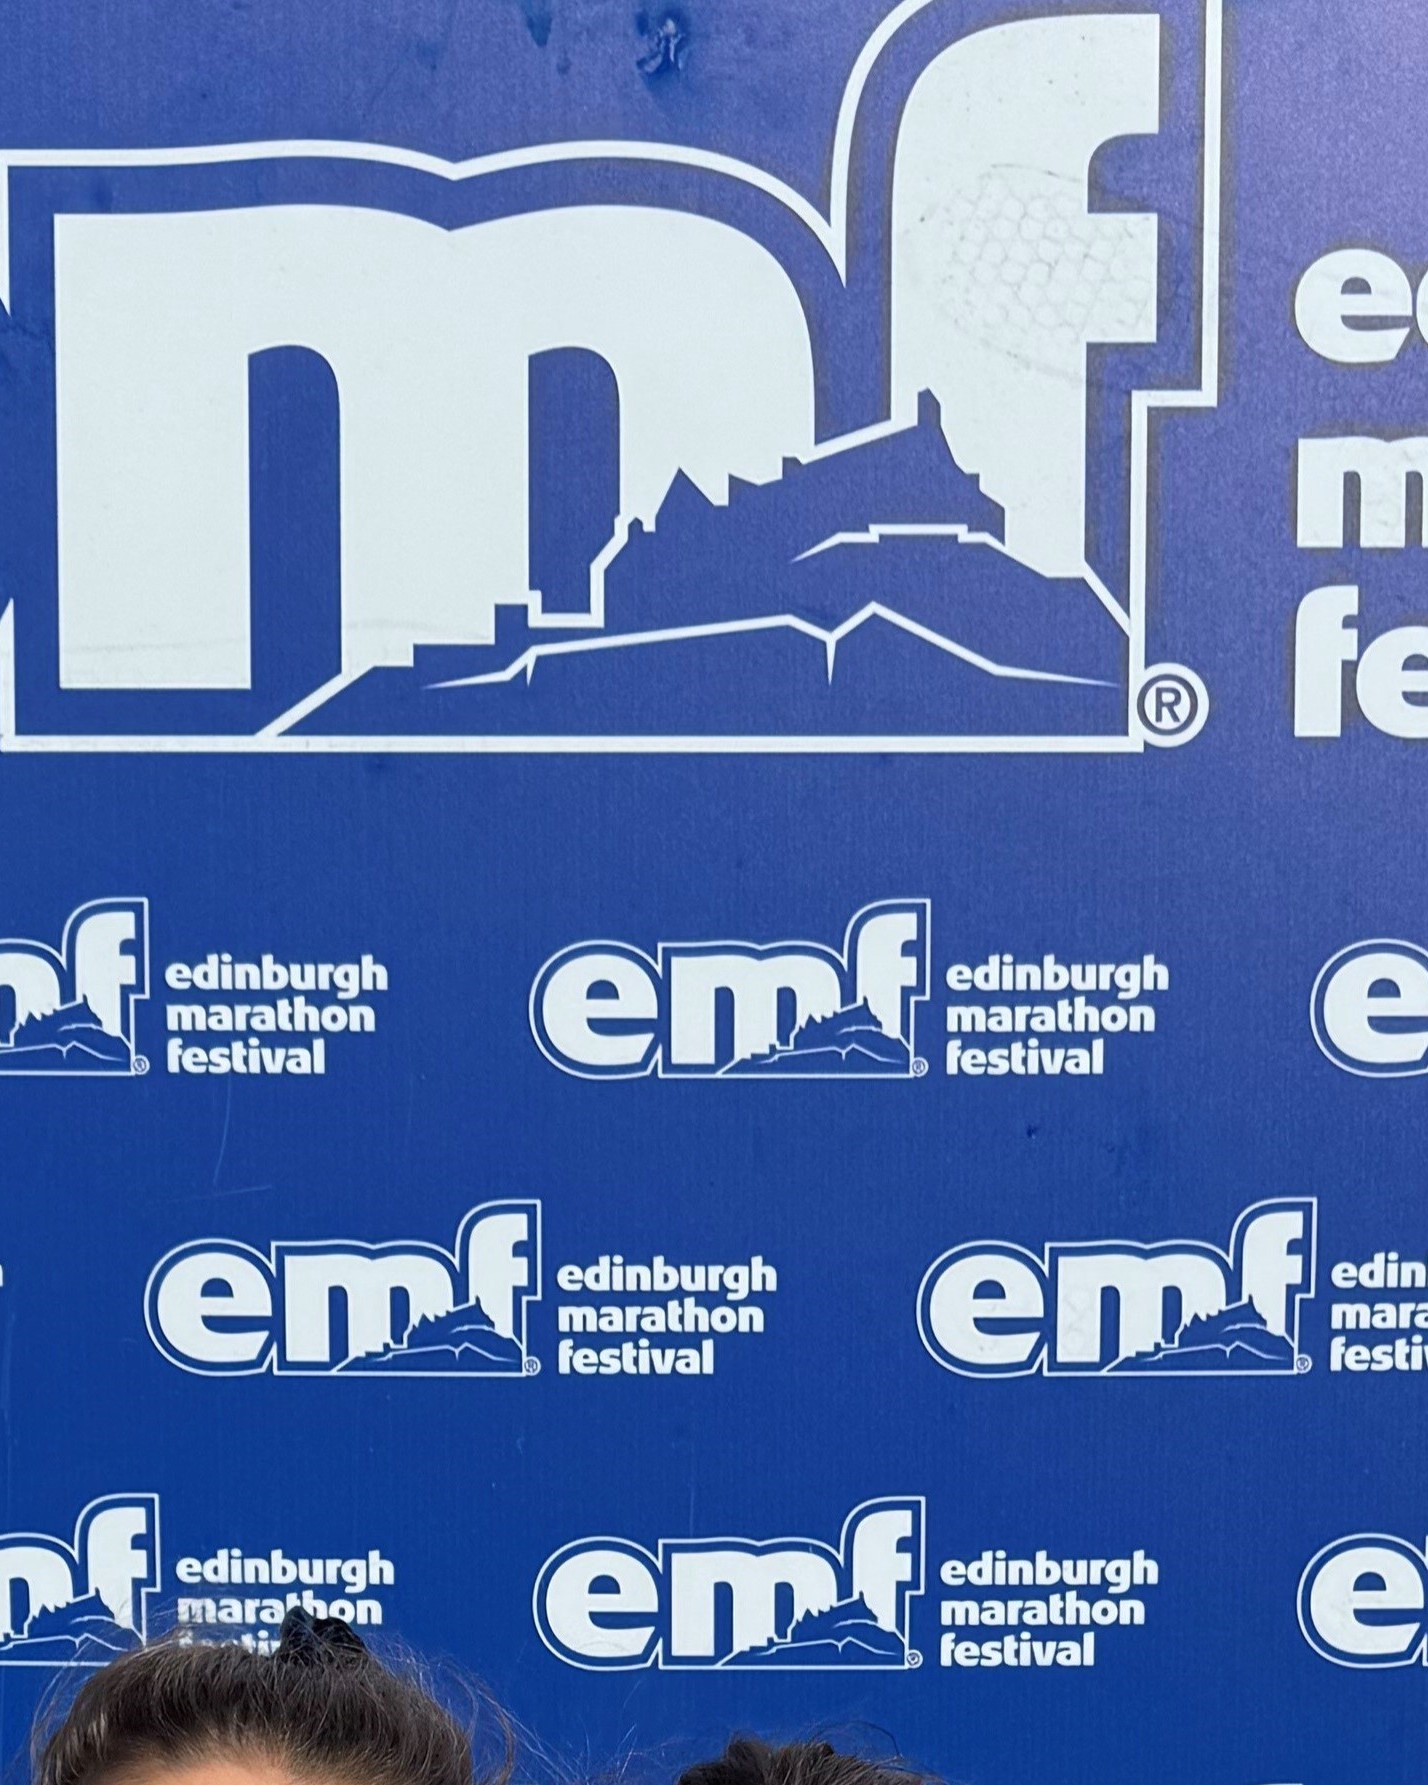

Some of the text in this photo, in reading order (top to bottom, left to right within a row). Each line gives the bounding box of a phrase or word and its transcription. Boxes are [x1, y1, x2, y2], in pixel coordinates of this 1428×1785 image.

[164, 953, 389, 1000] edinburgh
[536, 905, 924, 1072] emf
[945, 953, 1170, 1000] edinburgh
[166, 995, 376, 1032] marathon
[946, 995, 1156, 1033] marathon
[167, 1037, 326, 1074] festival
[946, 1037, 1104, 1076] festival
[151, 1206, 534, 1370] emf
[556, 1255, 778, 1301] edinburgh
[923, 1204, 1310, 1371] emf
[558, 1296, 765, 1333] marathon
[558, 1338, 714, 1375] festival
[540, 1503, 918, 1664] emf
[940, 1549, 1159, 1594] edinburgh
[940, 1590, 1146, 1626] marathon
[940, 1631, 1095, 1667] festival
